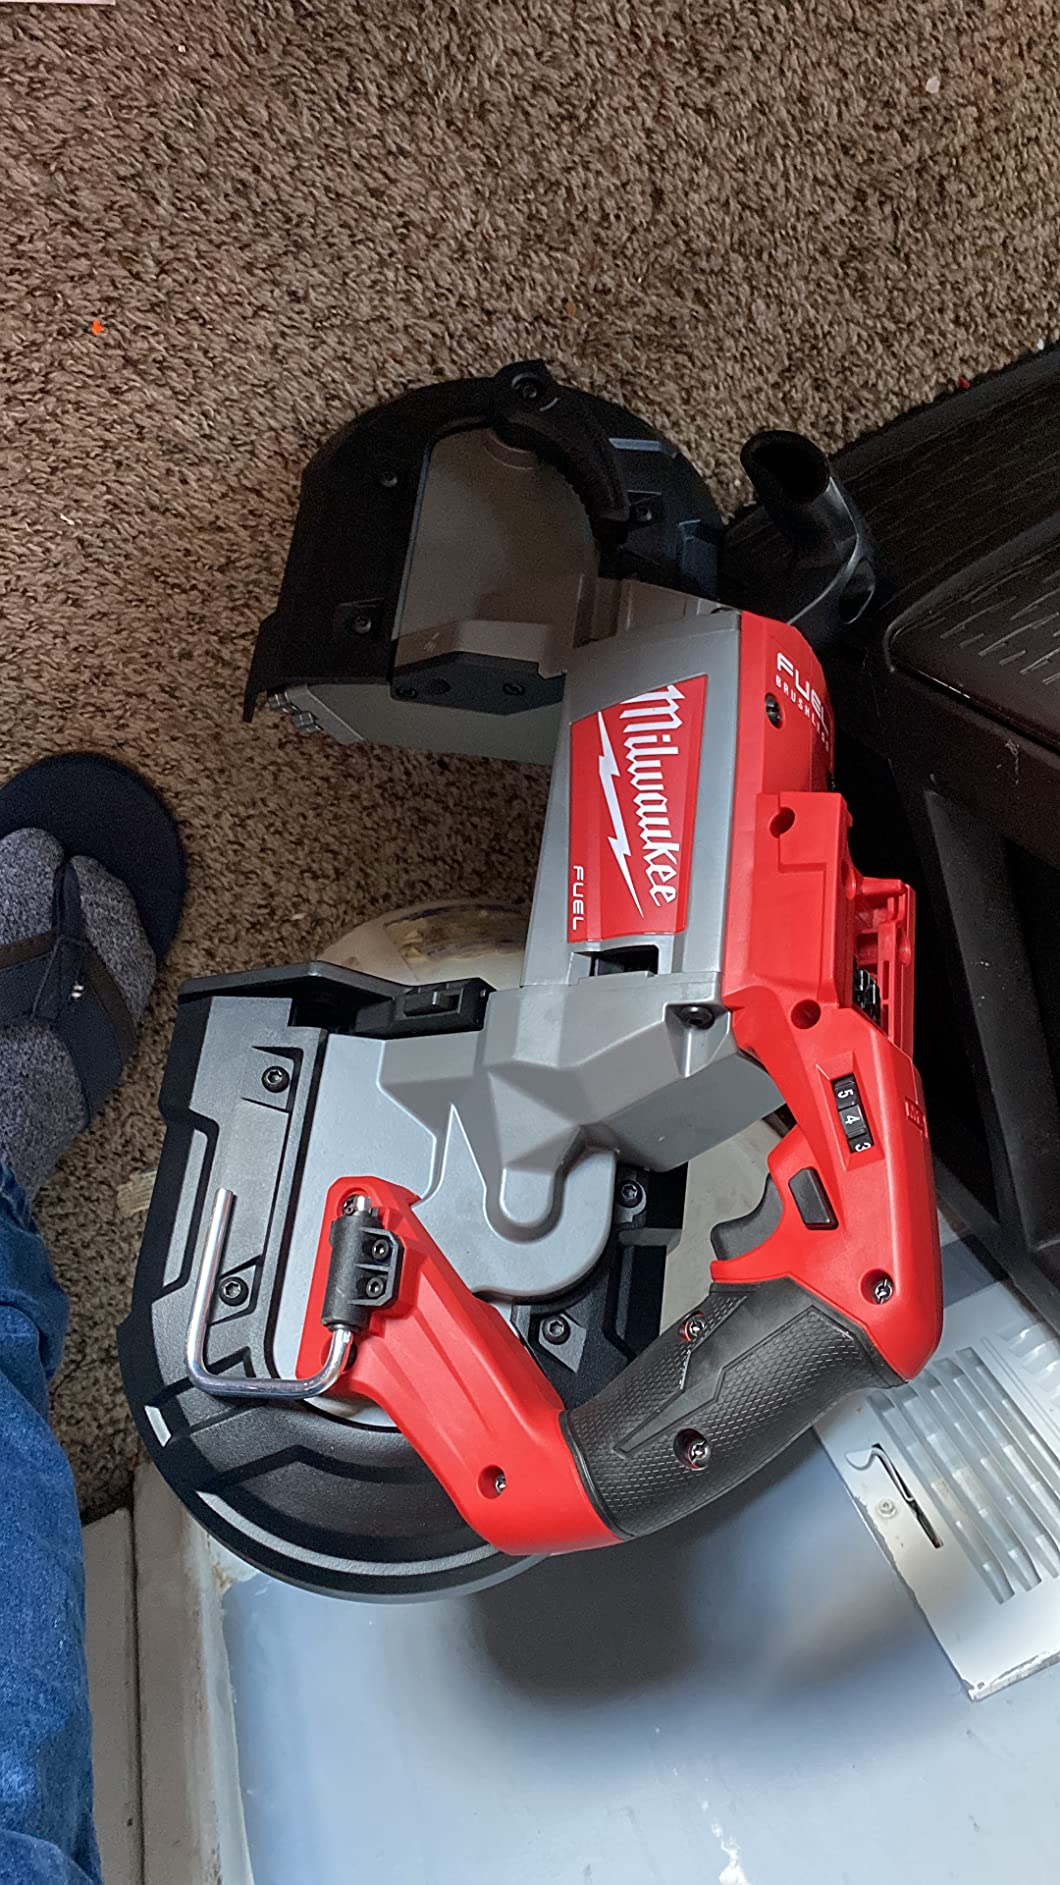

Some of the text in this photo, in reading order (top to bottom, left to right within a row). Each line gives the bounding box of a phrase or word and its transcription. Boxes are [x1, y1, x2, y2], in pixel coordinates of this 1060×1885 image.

[776, 652, 829, 737] FUEL
[618, 684, 686, 907] Milwaukee
[572, 865, 584, 931] FUEL
[838, 1089, 871, 1152] 5 4 3
